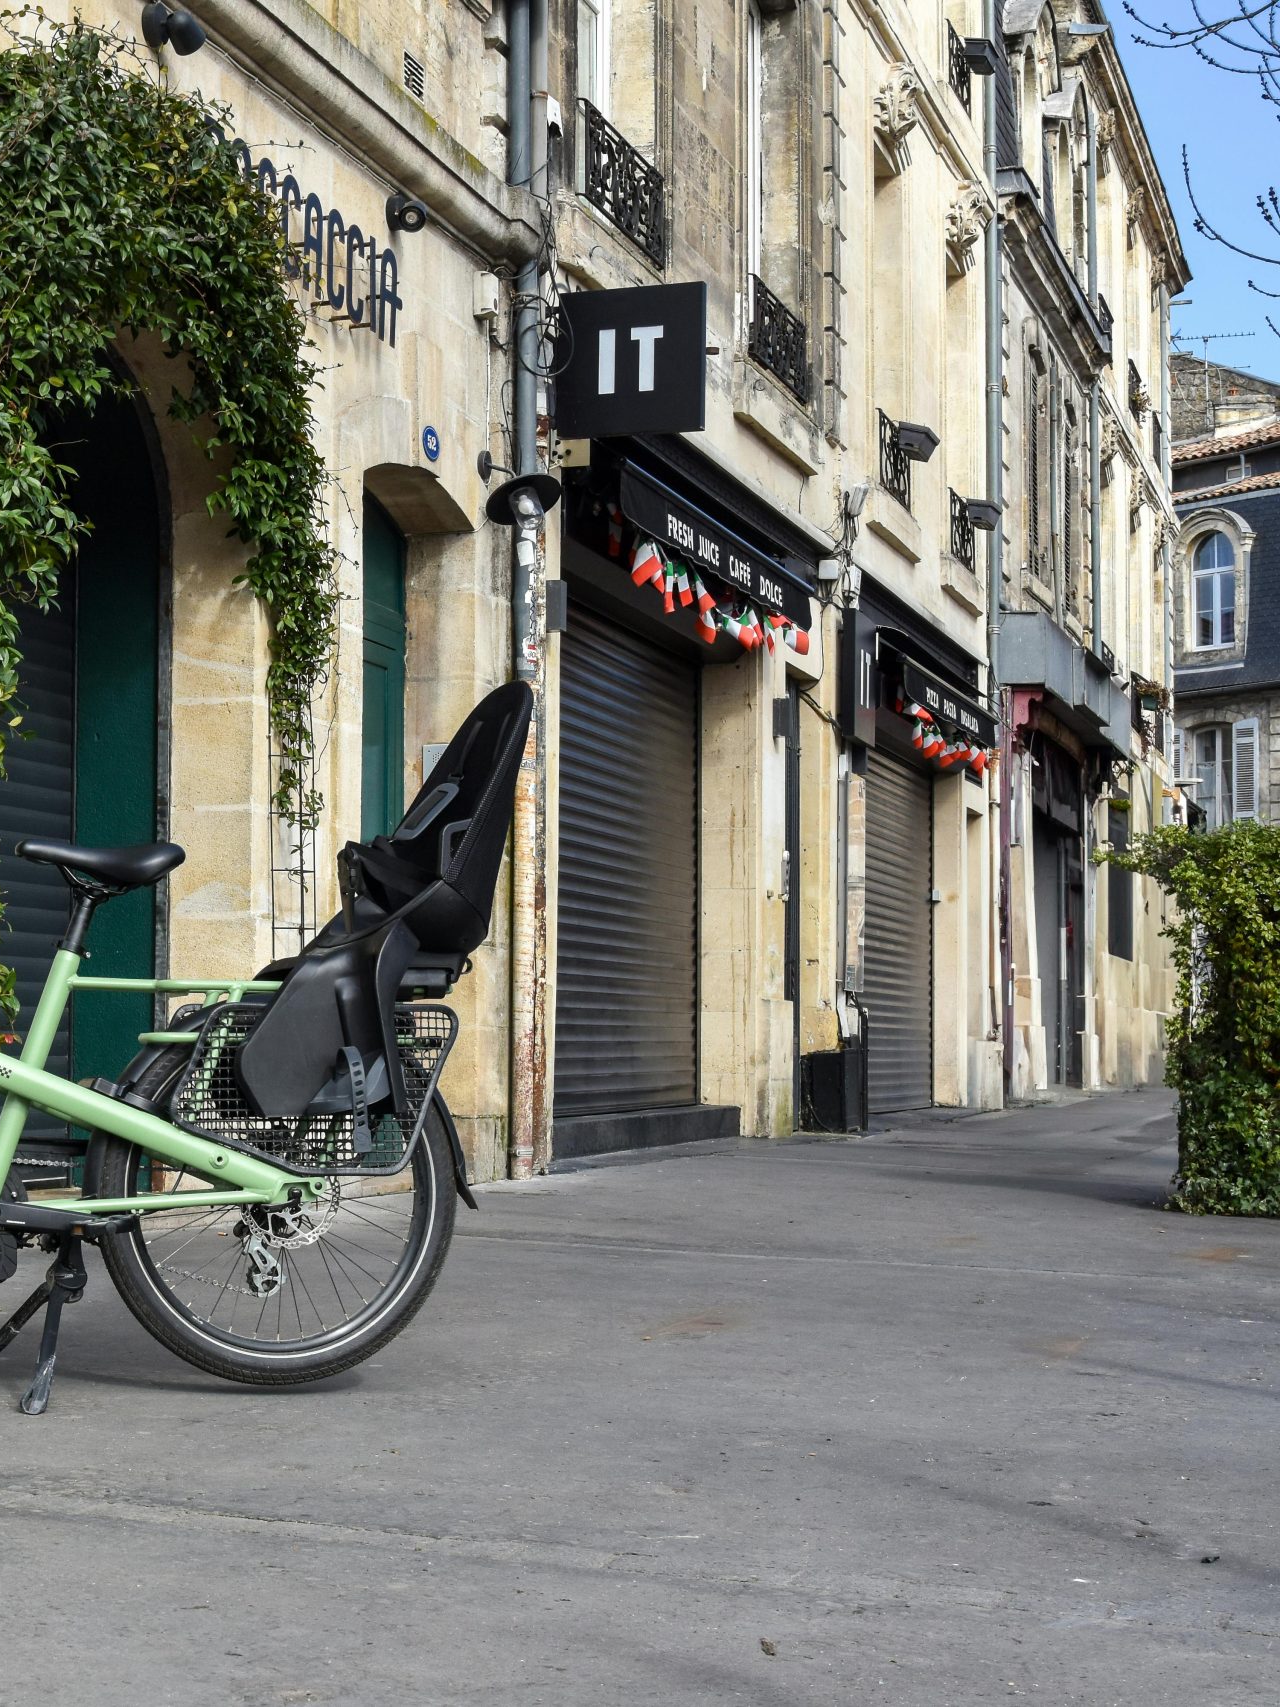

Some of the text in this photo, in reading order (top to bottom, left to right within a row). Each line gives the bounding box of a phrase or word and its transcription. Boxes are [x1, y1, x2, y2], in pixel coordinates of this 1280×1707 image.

[598, 325, 664, 395] IT
[427, 434, 437, 452] 52
[667, 513, 694, 551] FRESH
[697, 534, 720, 567] JUICE
[759, 574, 783, 608] DOLCE
[925, 686, 939, 710] PIZZA
[943, 698, 957, 720] PASTA
